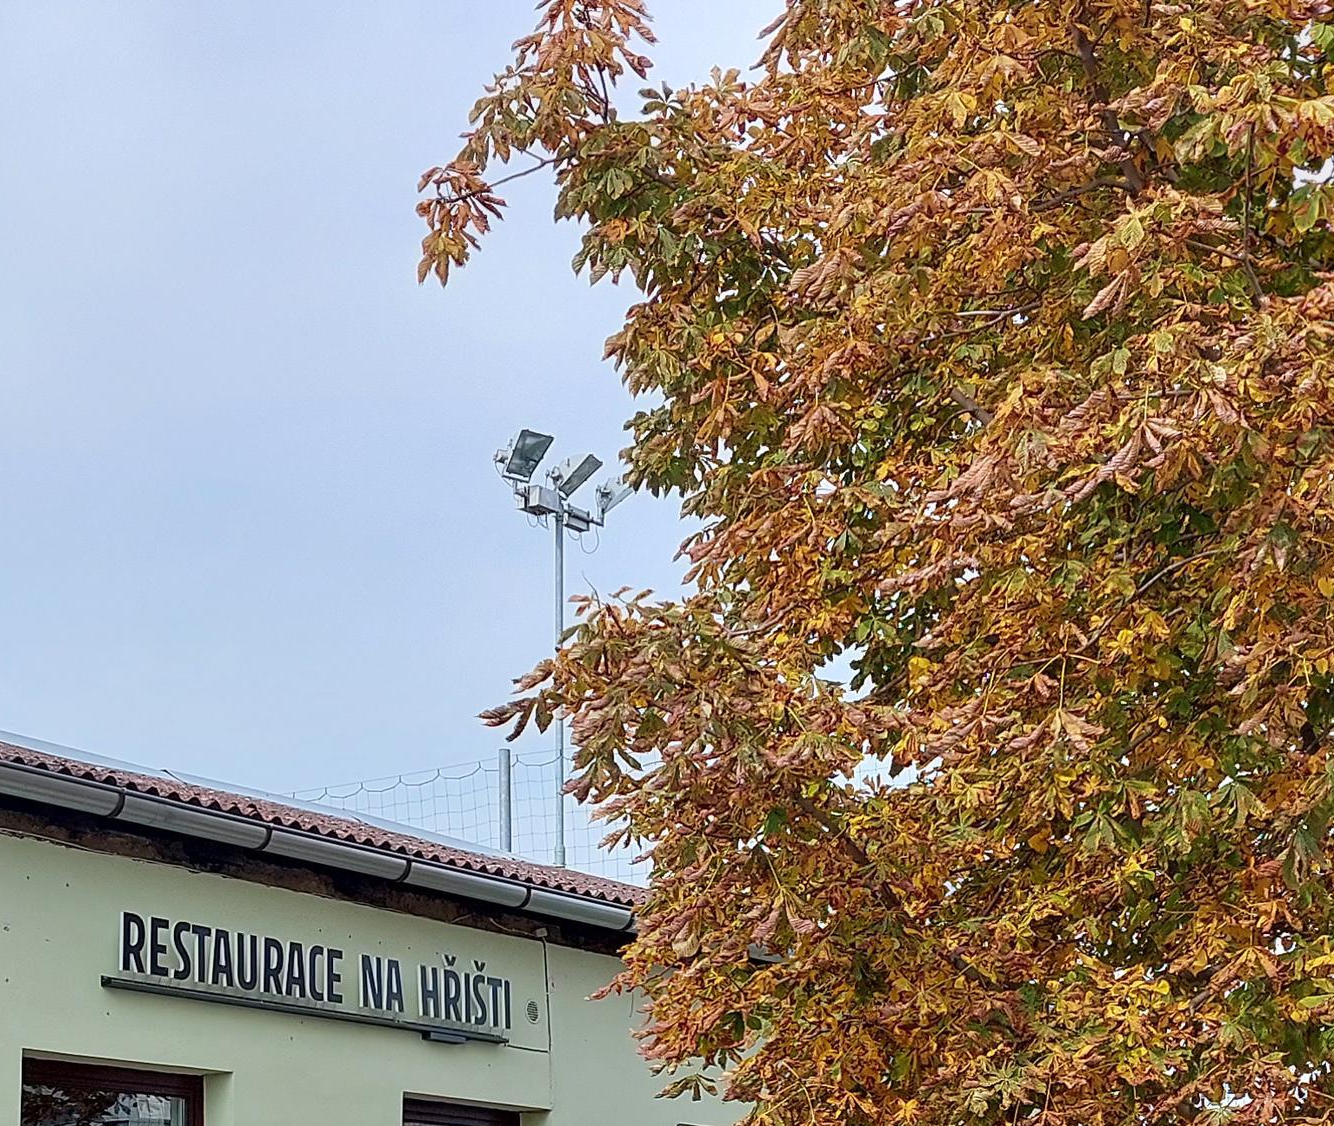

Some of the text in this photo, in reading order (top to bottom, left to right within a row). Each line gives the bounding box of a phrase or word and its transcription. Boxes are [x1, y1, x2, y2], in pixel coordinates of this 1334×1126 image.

[119, 911, 512, 1030] RESTAURACE NA HŘIŠTI
